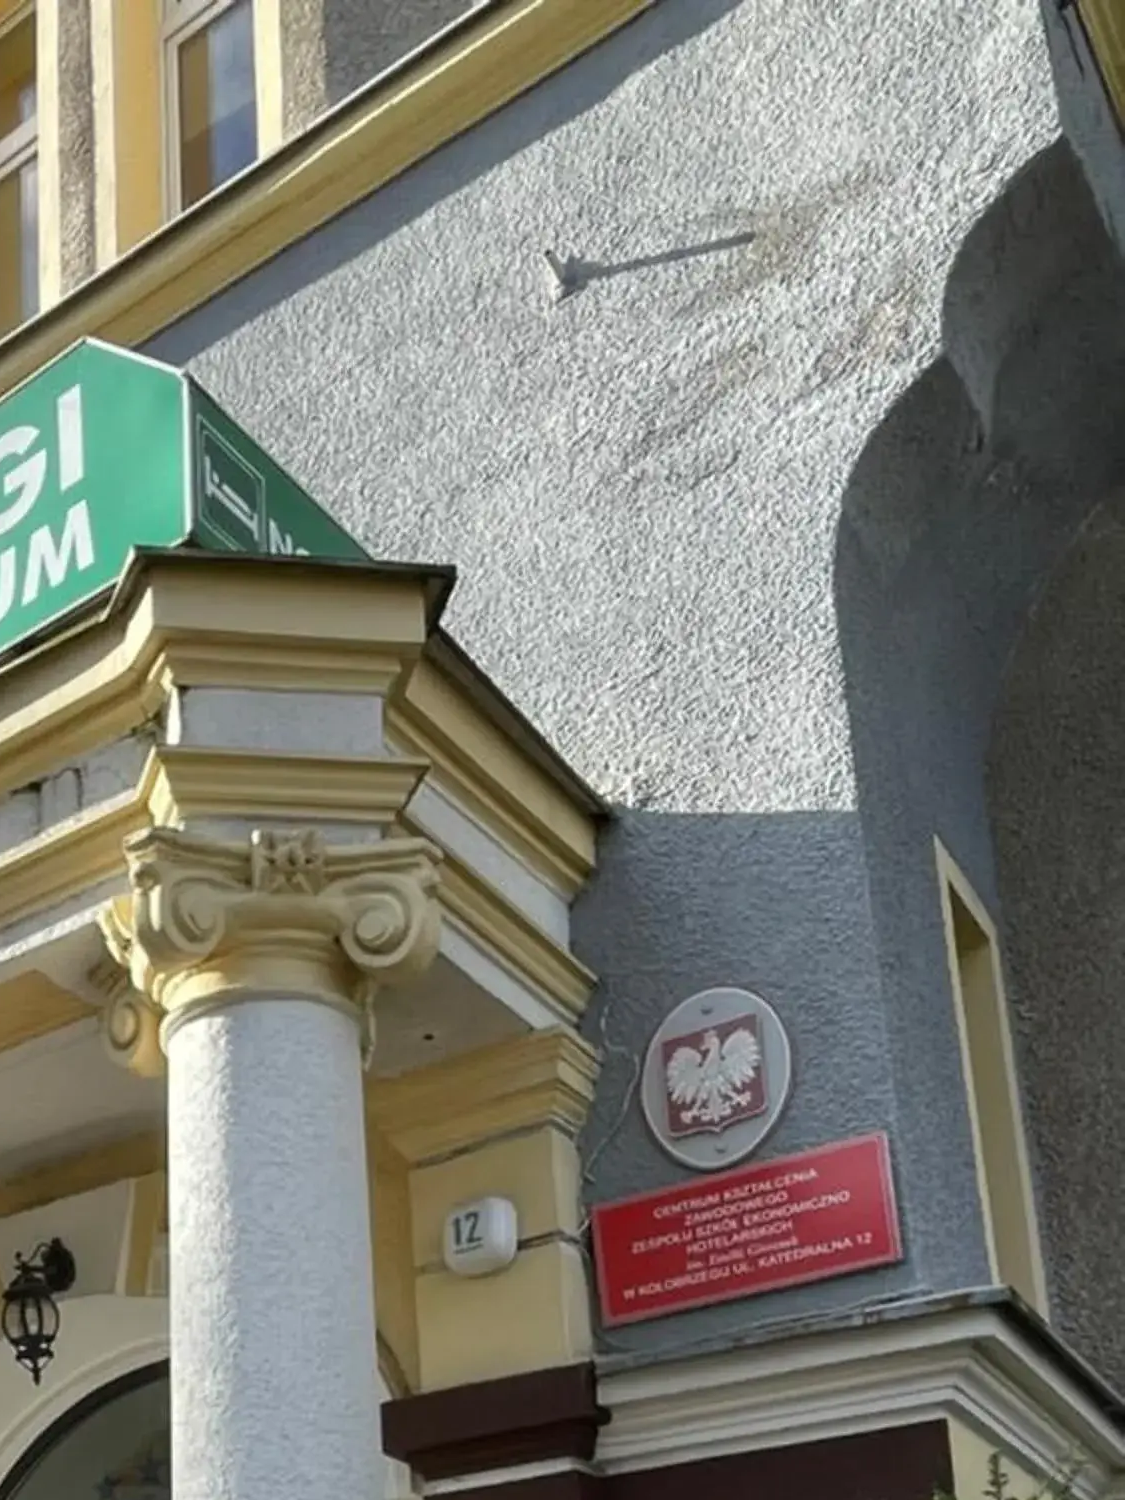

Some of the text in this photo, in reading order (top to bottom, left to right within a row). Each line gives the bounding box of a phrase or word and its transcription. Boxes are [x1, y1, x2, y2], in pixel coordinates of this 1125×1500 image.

[653, 1193, 720, 1219] CENTRUM
[684, 1190, 788, 1226] ZAWODOWEGO
[453, 1211, 483, 1246] 12
[623, 1287, 635, 1300] W
[758, 1237, 853, 1268] KATEDRALNA
[856, 1231, 872, 1245] 12
